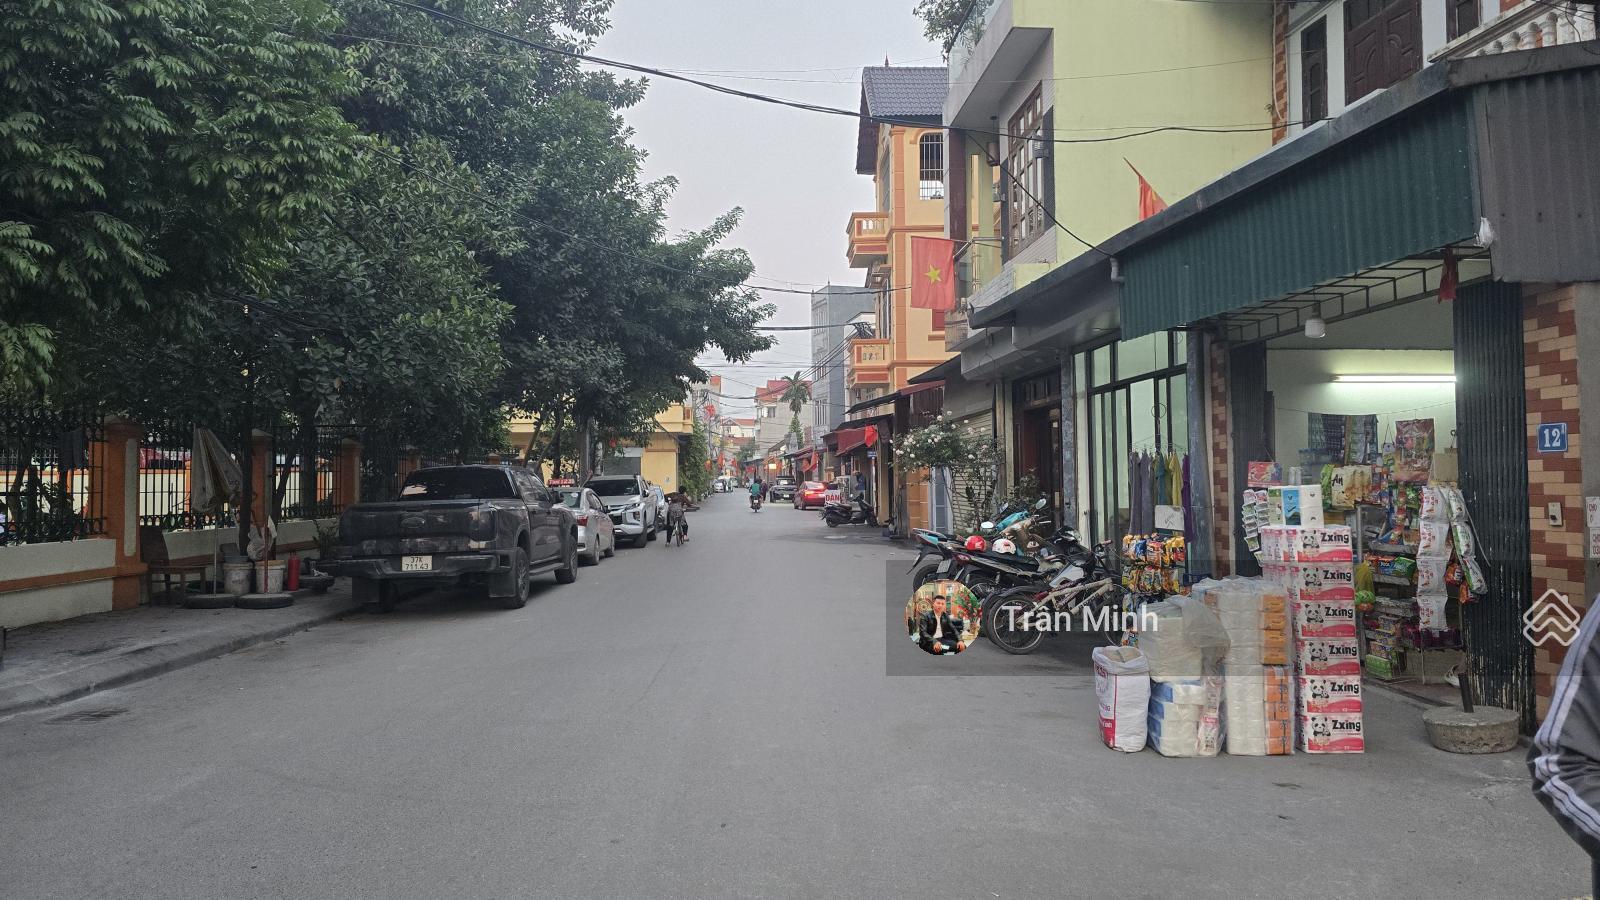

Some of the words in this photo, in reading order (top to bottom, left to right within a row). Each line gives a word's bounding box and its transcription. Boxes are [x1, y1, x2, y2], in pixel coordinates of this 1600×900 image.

[1543, 428, 1561, 448] 12
[1320, 532, 1350, 544] Zxing
[1323, 570, 1352, 583] Zxing
[1325, 606, 1354, 619] Zxing
[1328, 644, 1357, 658] Zxing
[1330, 681, 1360, 694] Zxing
[1331, 719, 1361, 731] Zxing
